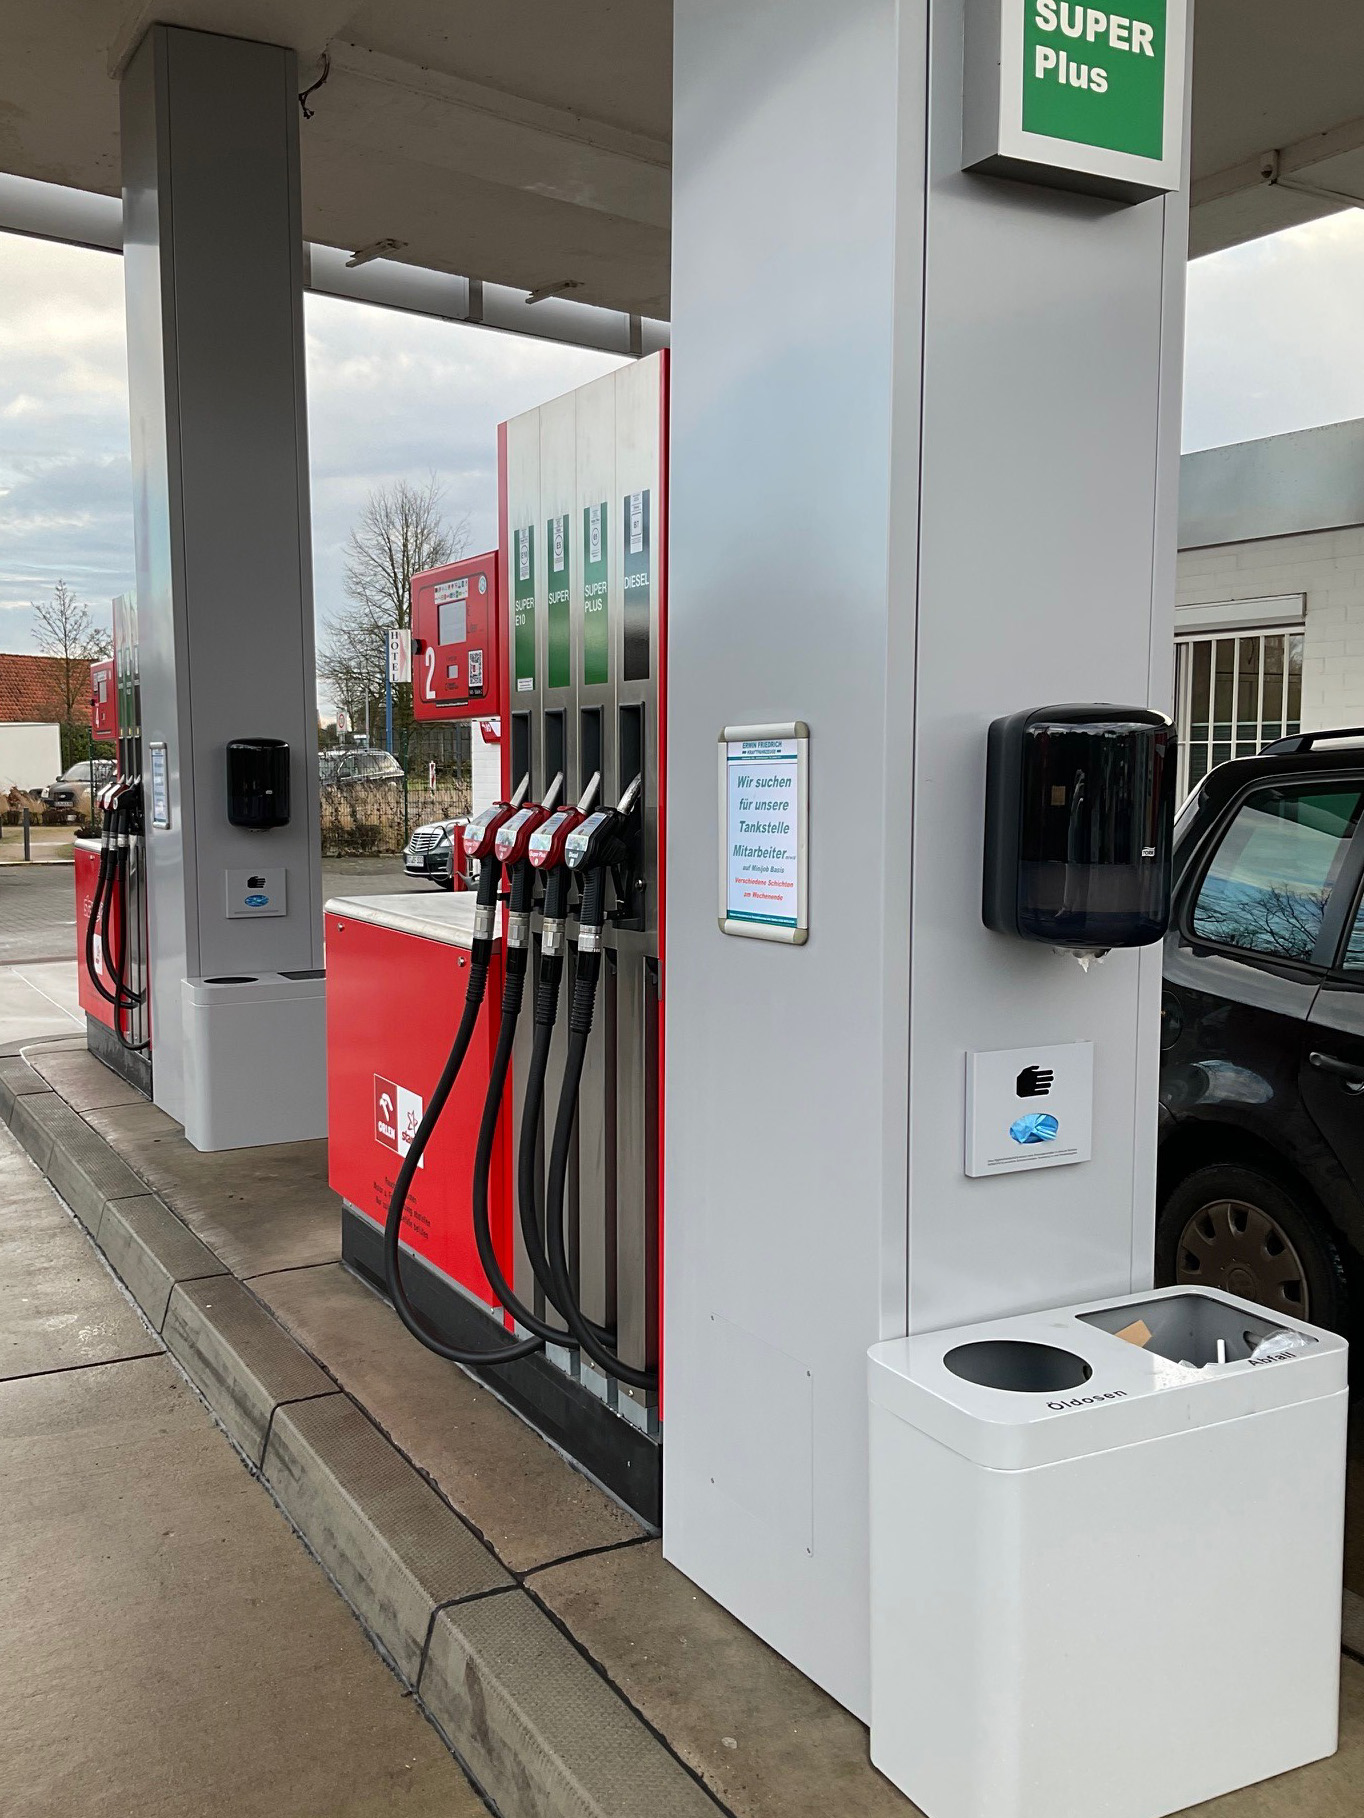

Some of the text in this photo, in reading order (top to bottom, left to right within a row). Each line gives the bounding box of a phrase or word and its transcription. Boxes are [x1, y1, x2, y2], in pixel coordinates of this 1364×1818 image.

[1035, 0, 1155, 57] SUPER
[1035, 44, 1108, 93] Plus
[584, 581, 607, 597] SUPER
[624, 572, 650, 590] DIESEL
[515, 597, 535, 612] SUPER
[548, 589, 570, 605] SUPER
[584, 598, 603, 613] PLUS
[515, 613, 526, 627] E10
[391, 631, 399, 682] HOTEL
[425, 647, 436, 700] 2
[737, 775, 792, 789] Wir suchen
[738, 798, 789, 812] für unsere
[738, 820, 790, 835] Tankstelle
[733, 844, 787, 860] Mitarbeiter
[751, 865, 769, 873] Minijob
[767, 879, 794, 888] Schichten
[752, 891, 784, 901] Wochenende
[377, 1120, 396, 1141] ORLEN
[1247, 1350, 1297, 1368] Abfall
[1047, 1388, 1128, 1411] Öldosen
